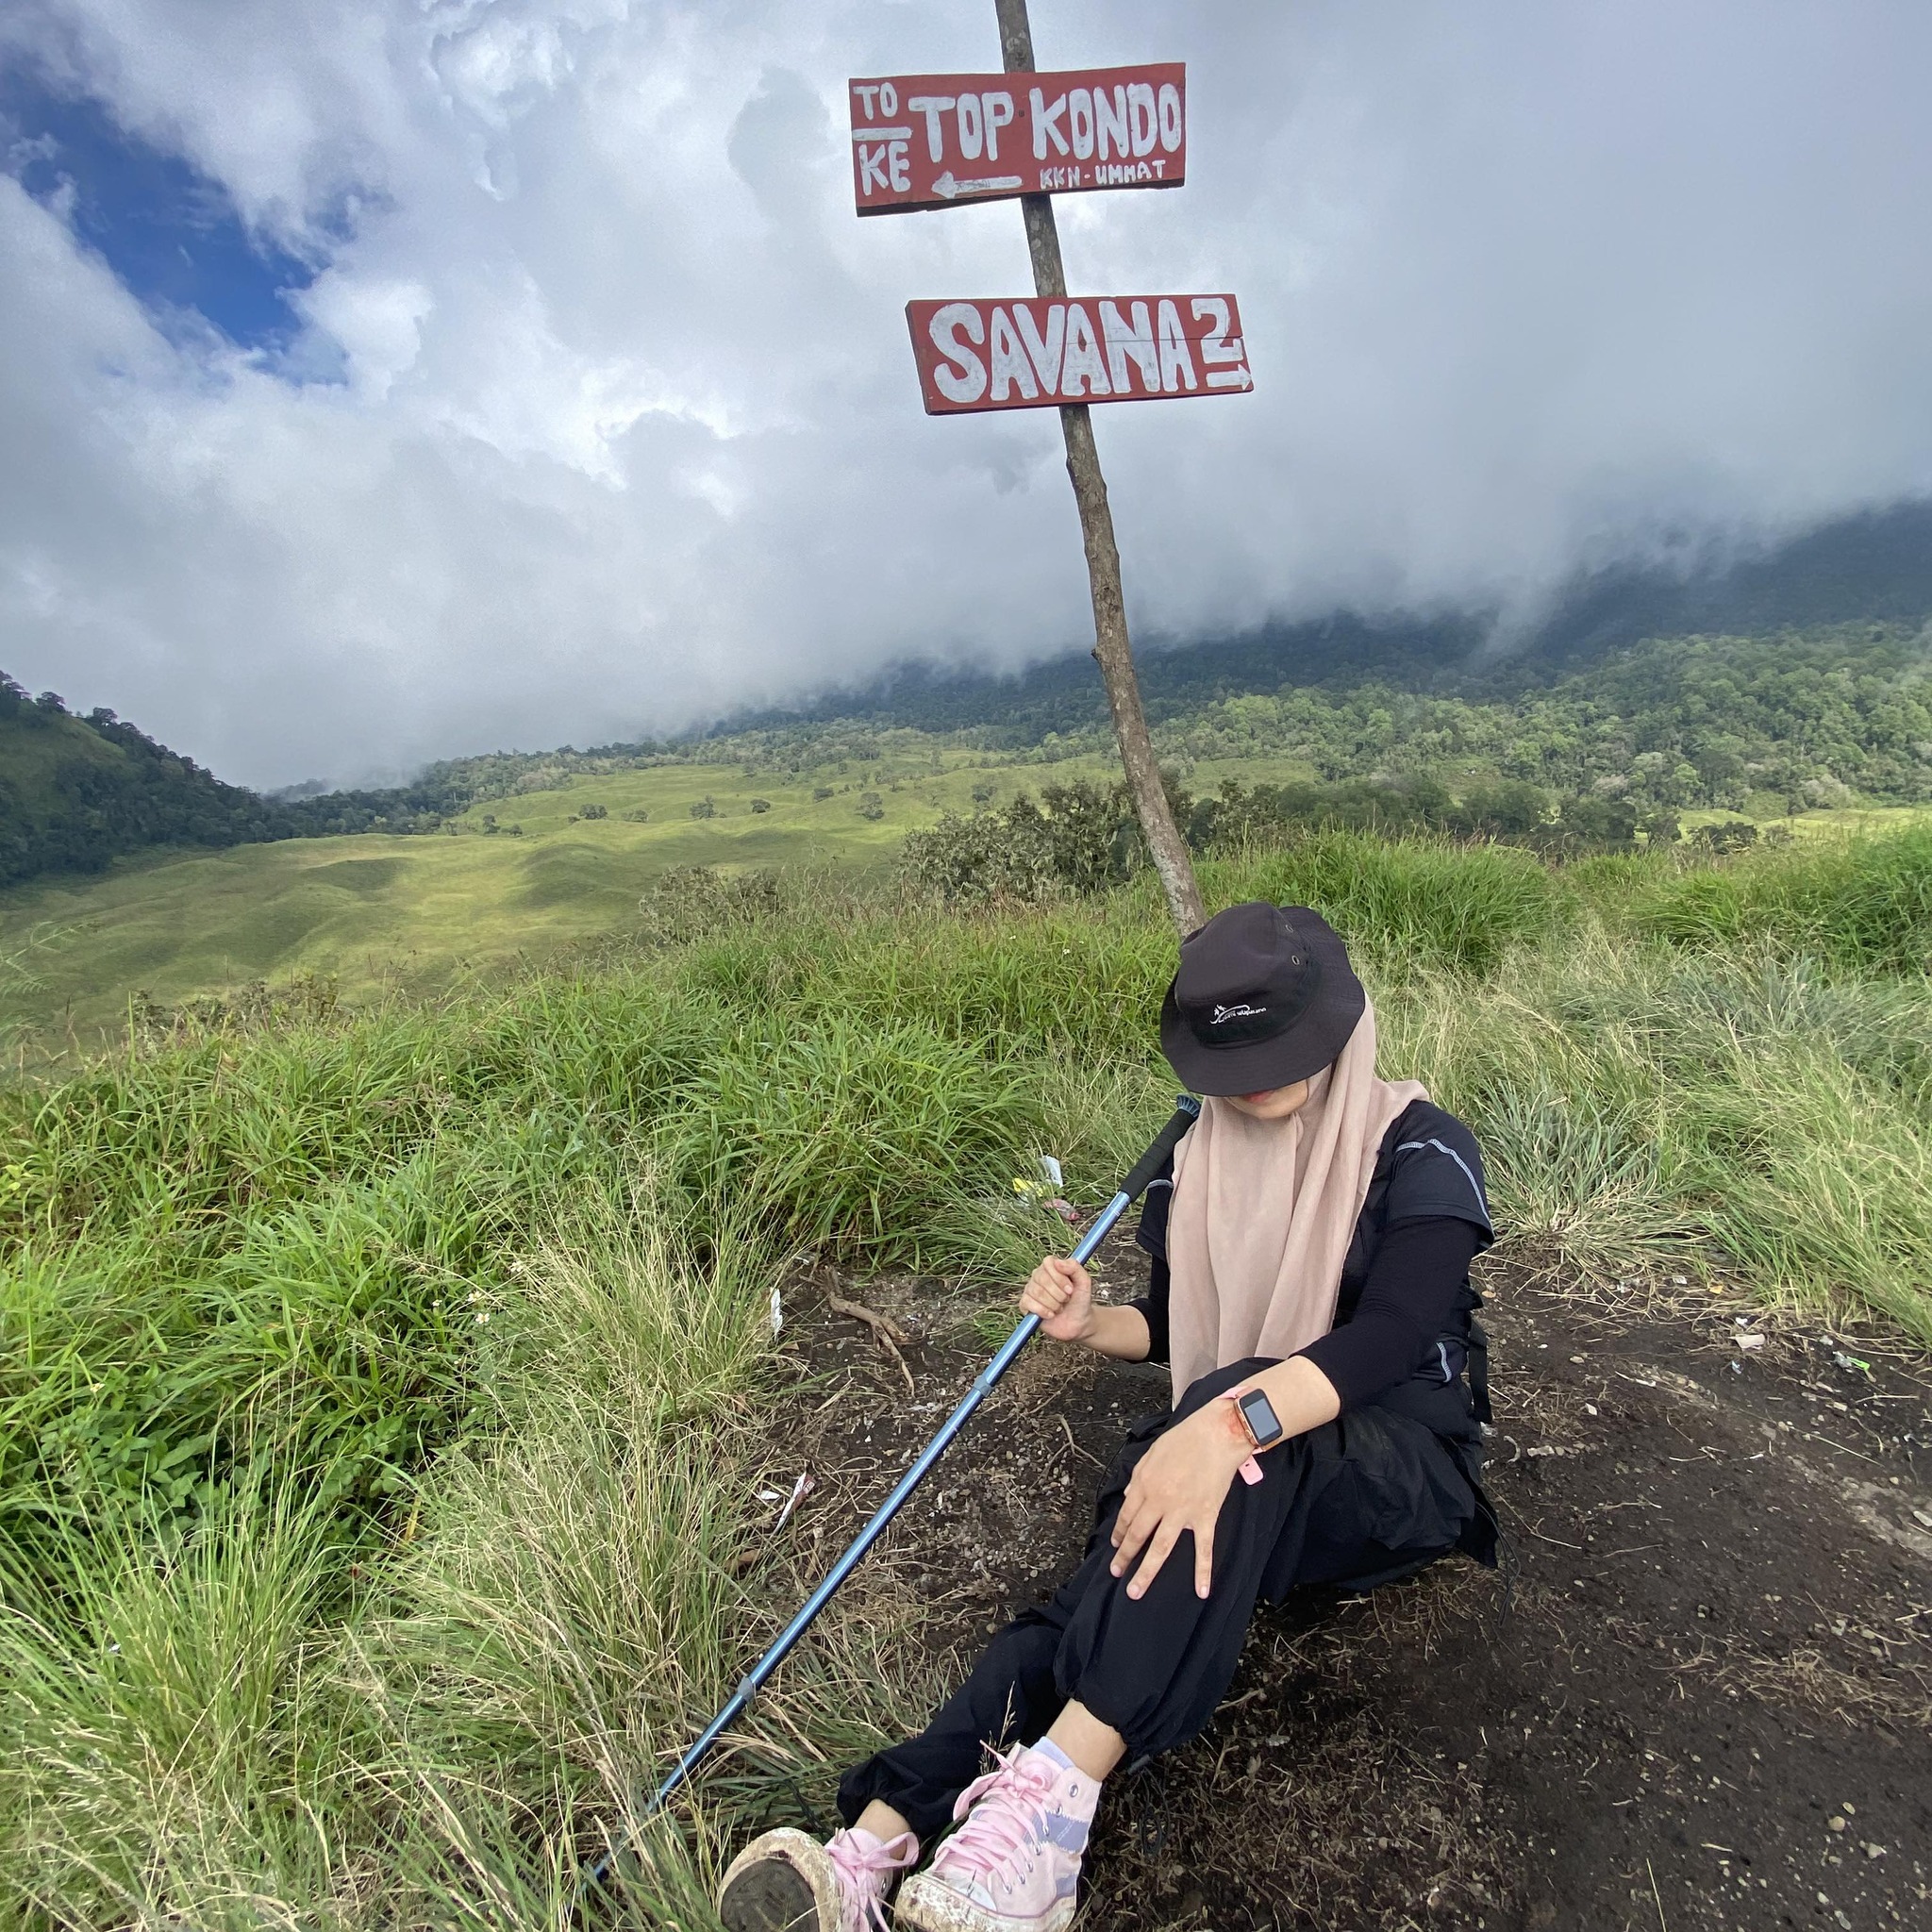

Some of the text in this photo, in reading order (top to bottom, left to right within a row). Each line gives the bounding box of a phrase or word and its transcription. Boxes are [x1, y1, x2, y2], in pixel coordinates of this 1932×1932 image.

[854, 82, 898, 120] TO
[908, 83, 1182, 163] TOP KONDO
[859, 142, 911, 195] KE
[929, 298, 1243, 404] SAVANA 2
